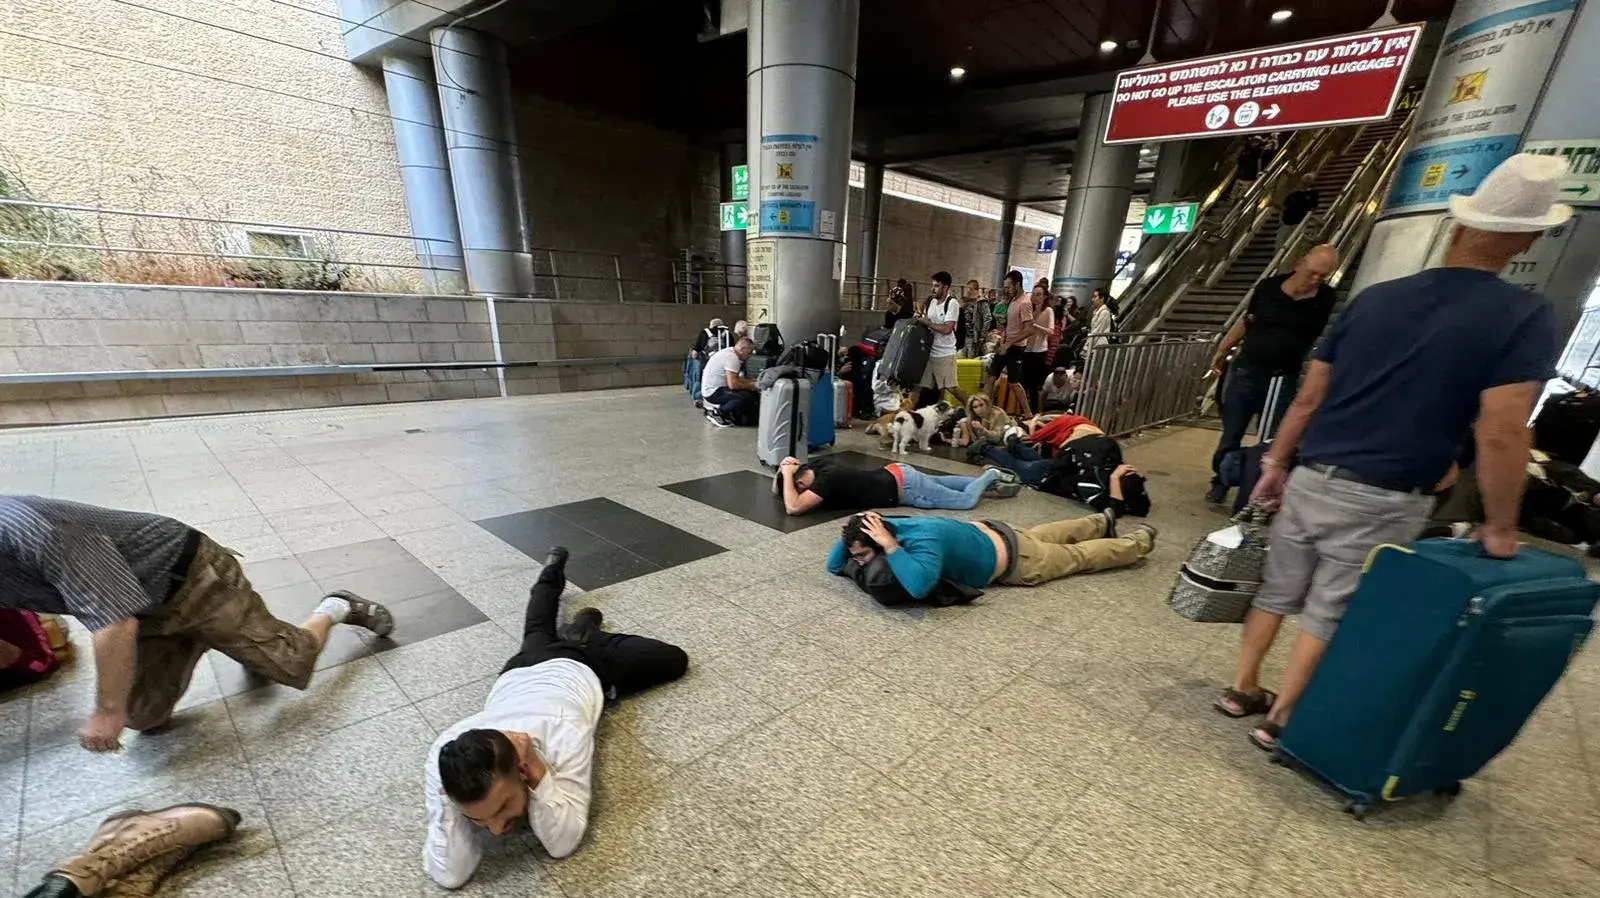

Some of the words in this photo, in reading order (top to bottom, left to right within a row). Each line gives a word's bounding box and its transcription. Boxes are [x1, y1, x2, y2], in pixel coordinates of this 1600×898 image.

[1331, 37, 1383, 59] לעלות
[1383, 35, 1412, 55] אין
[1259, 52, 1302, 69] כבודה
[1304, 47, 1330, 62] עם
[1169, 61, 1229, 82] להשתמש
[1229, 60, 1248, 73] נא
[1116, 92, 1131, 103] DO
[1131, 89, 1152, 101] NOT
[1151, 86, 1167, 99] GO
[1167, 84, 1184, 97] UP
[1183, 82, 1204, 94] THE
[1203, 73, 1269, 92] ESCALATOR
[1268, 65, 1331, 83] CARRYING
[1330, 54, 1396, 75] LUGGAGE
[1119, 72, 1167, 89] במעליות
[1167, 94, 1206, 108] PLEASE
[1206, 90, 1229, 102] USE
[1230, 87, 1252, 100] THE
[1252, 79, 1321, 98] ELEVATORS
[1509, 261, 1537, 276] דרך
